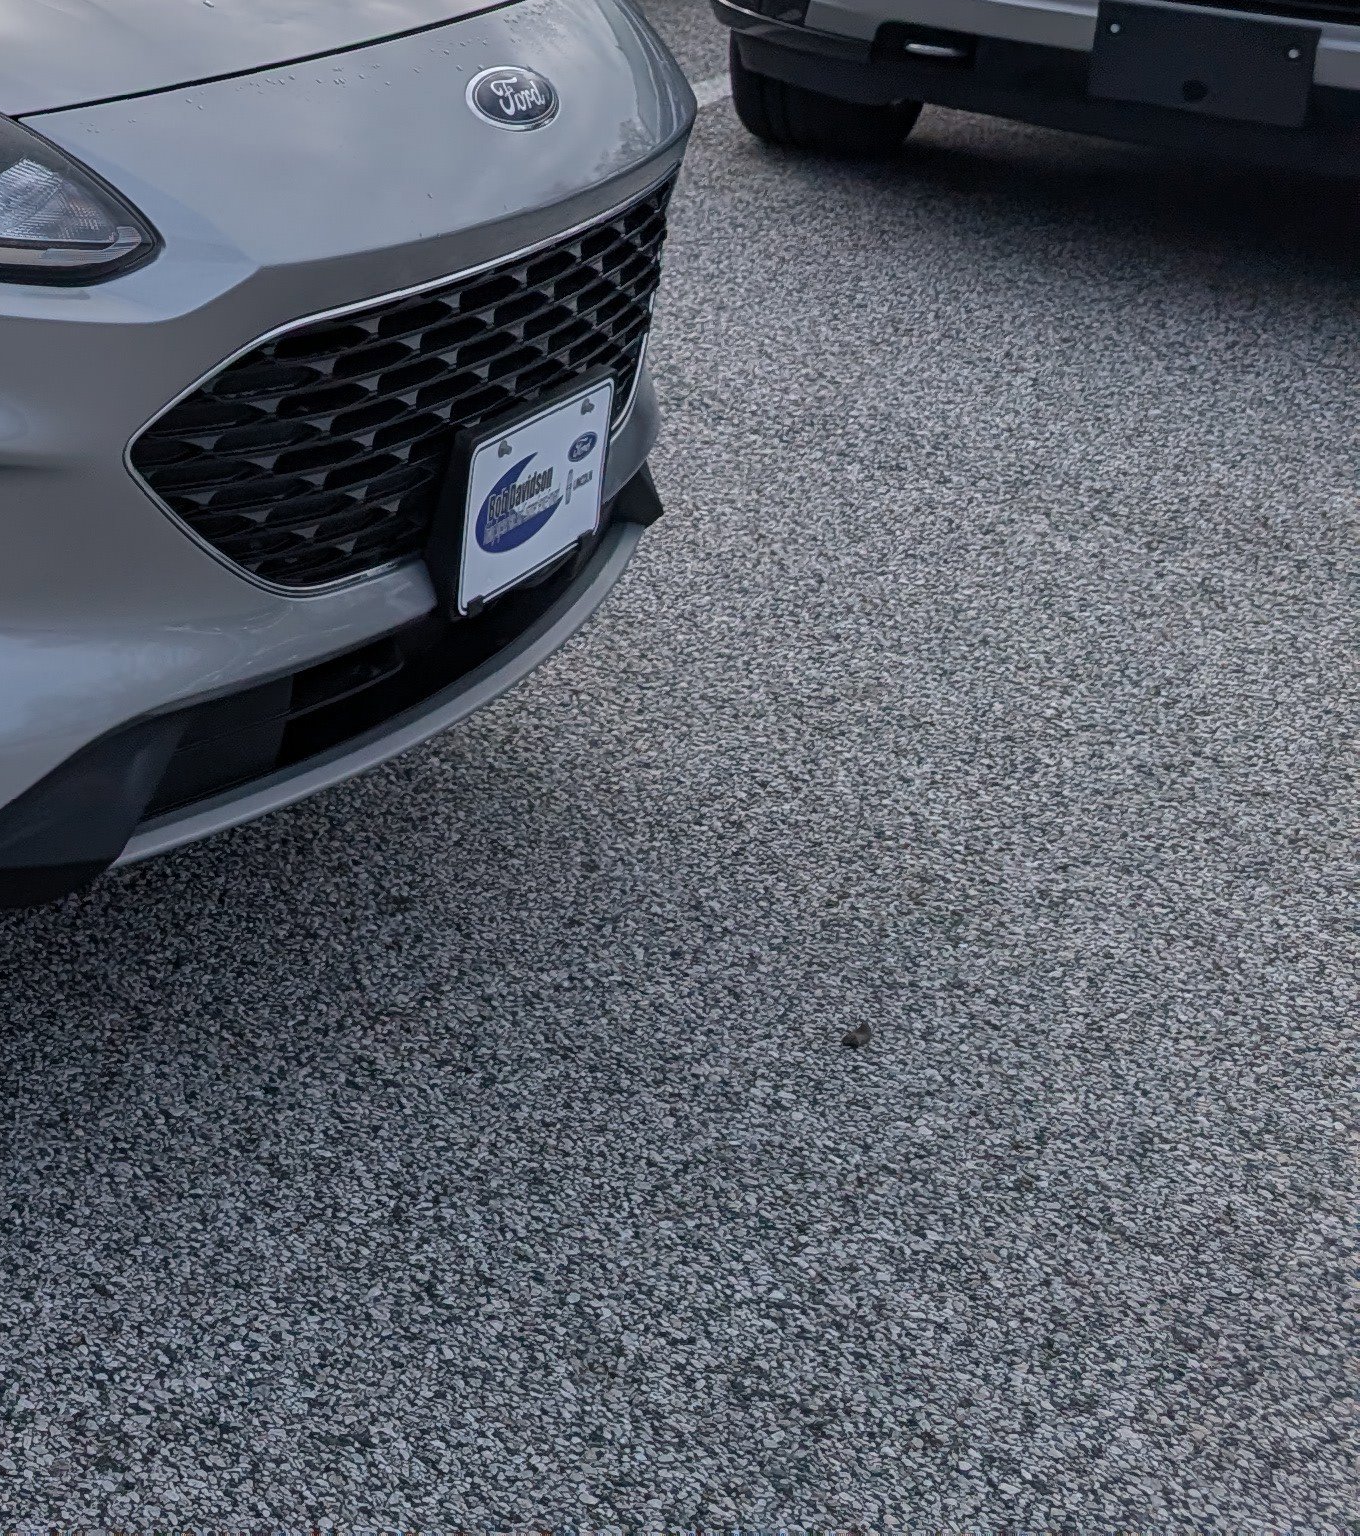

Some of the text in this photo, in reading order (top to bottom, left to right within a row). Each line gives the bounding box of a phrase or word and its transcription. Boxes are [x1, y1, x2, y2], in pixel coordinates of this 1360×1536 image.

[490, 76, 546, 116] Ford
[488, 489, 509, 522] Bob
[509, 467, 554, 509] Davidson
